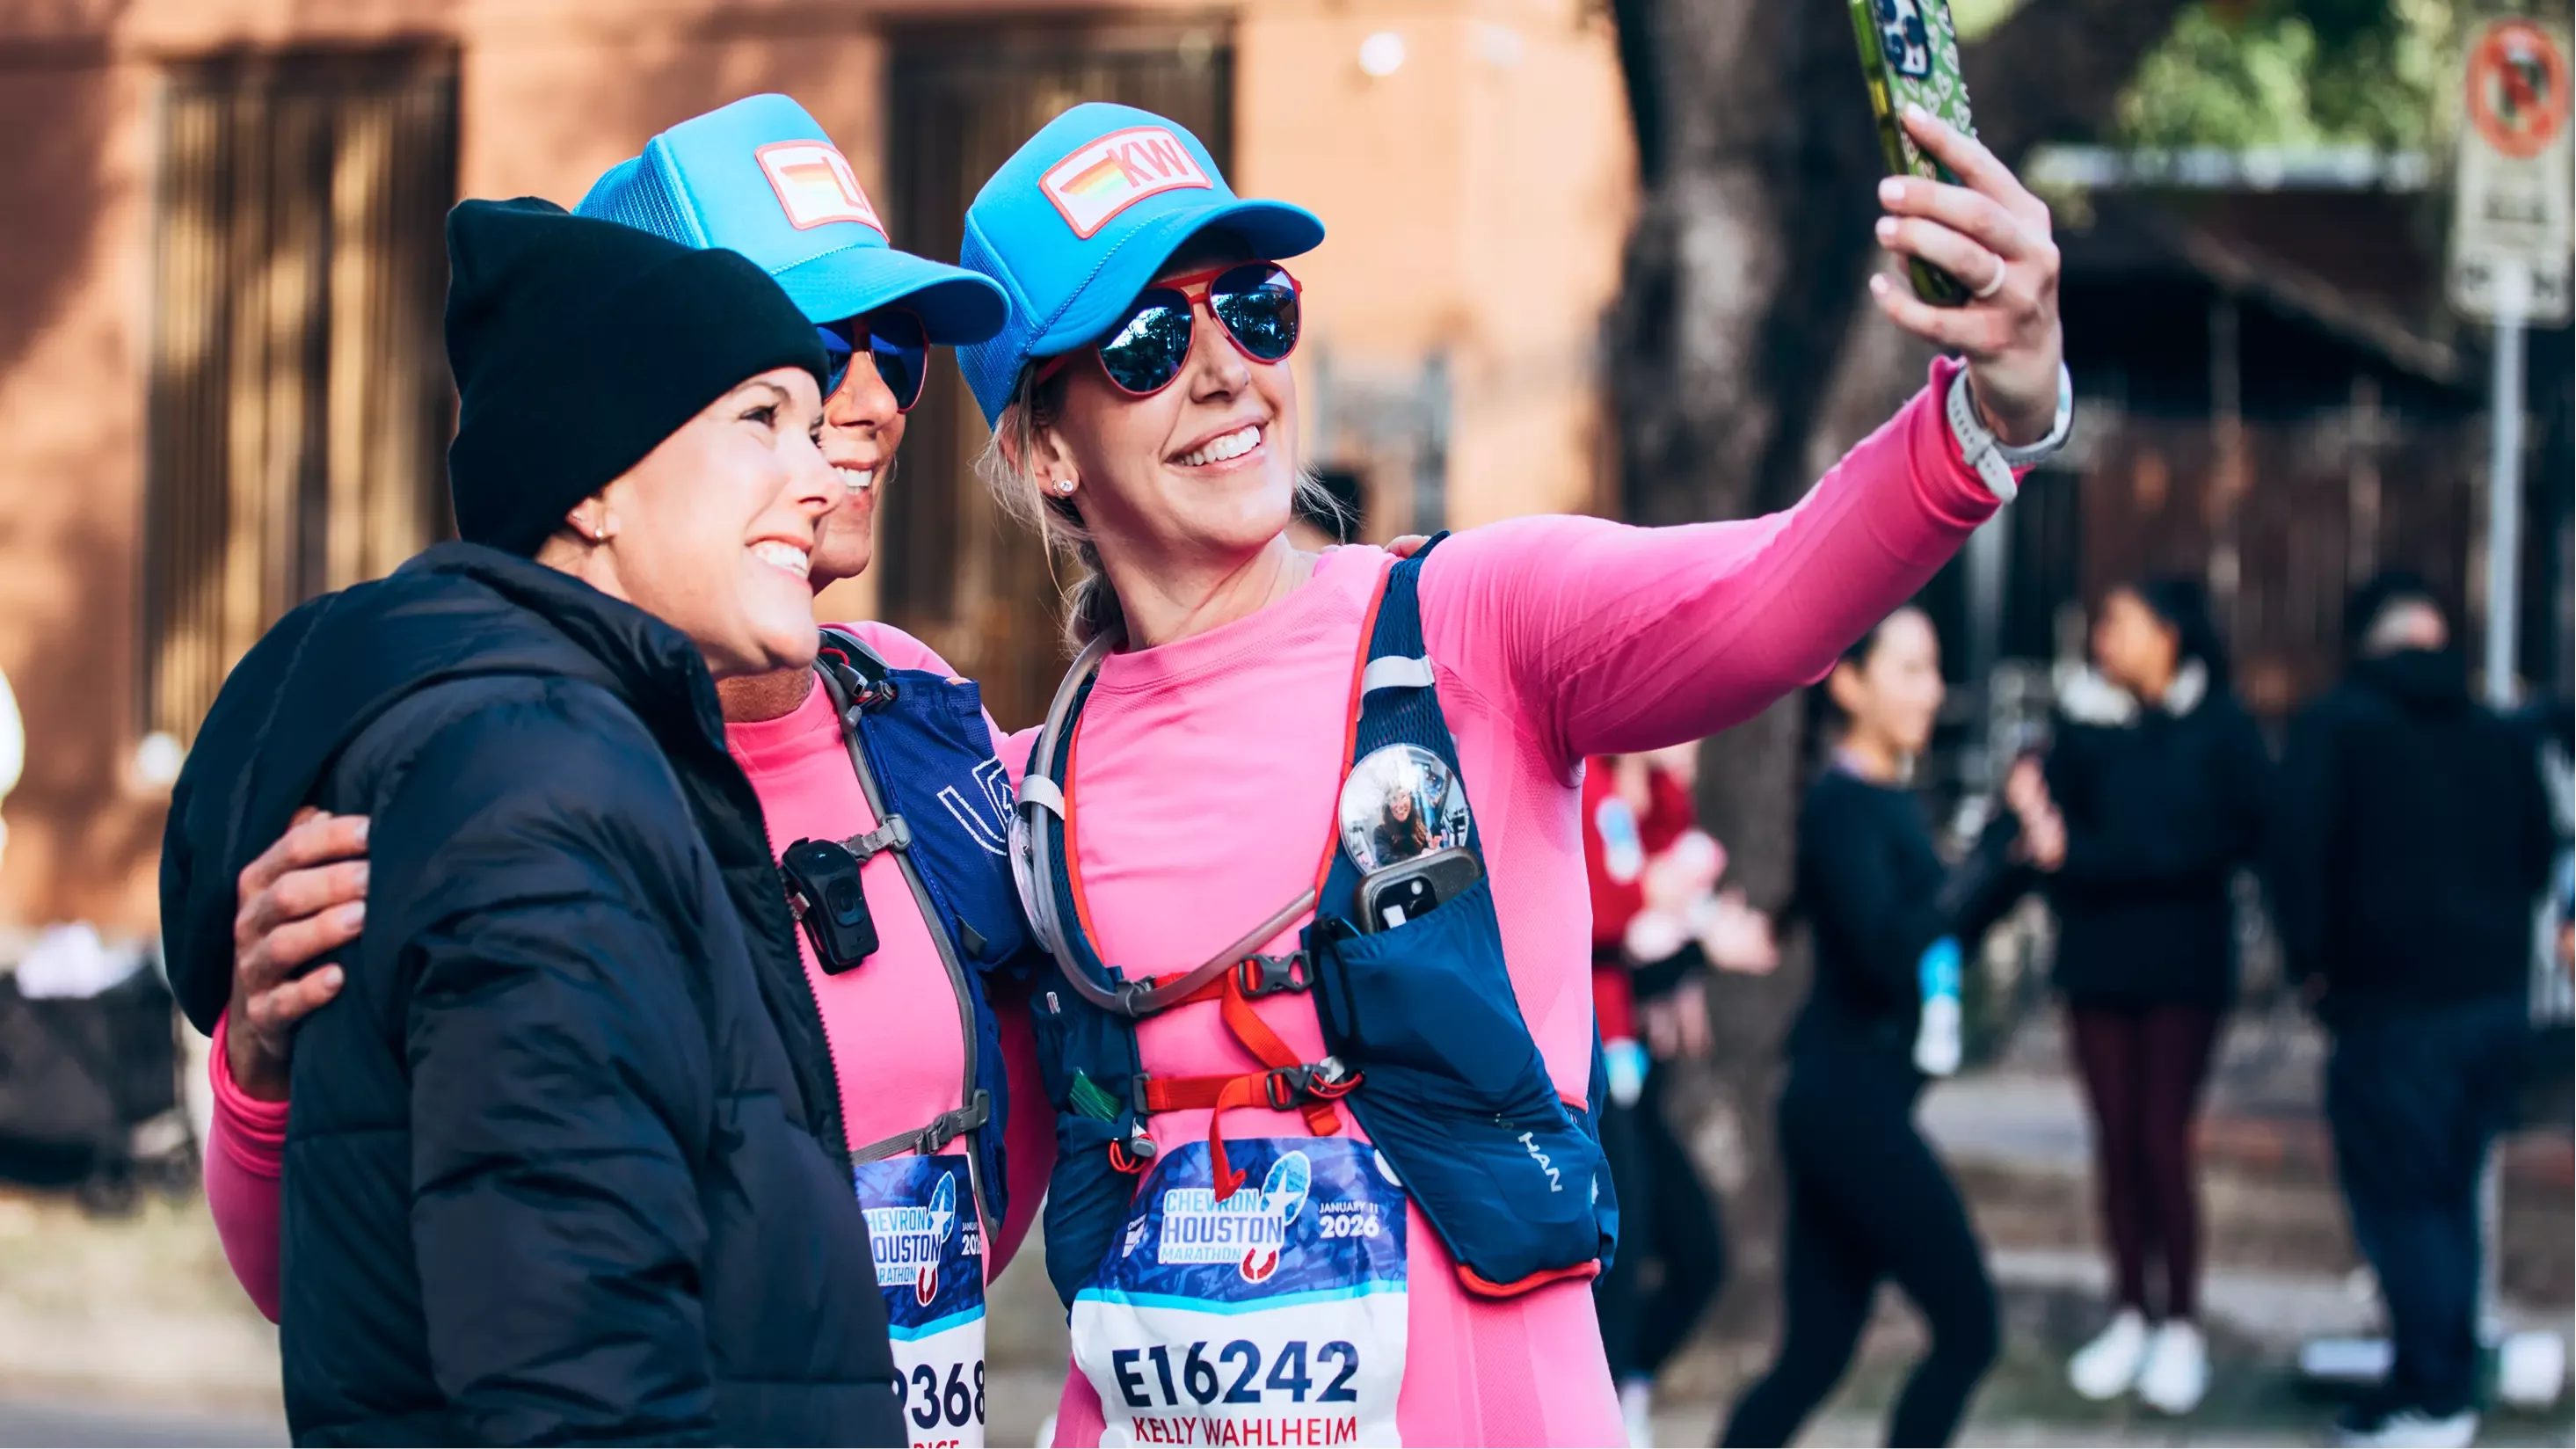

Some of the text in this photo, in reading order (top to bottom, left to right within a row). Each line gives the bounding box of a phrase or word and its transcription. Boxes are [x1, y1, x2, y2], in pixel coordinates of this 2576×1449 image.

[1106, 139, 1190, 188] KW
[1517, 1132, 1563, 1192] HAN
[862, 1209, 926, 1233] HEVRON
[1319, 1201, 1379, 1213] JANUARY 11
[1163, 1216, 1283, 1244] HOUSTON
[1319, 1214, 1380, 1239] 2026
[872, 1234, 942, 1263] OUSTON
[1161, 1247, 1242, 1261] MARATHON
[879, 1266, 916, 1283] RATHON
[1112, 1339, 1359, 1408] E16242
[1132, 1416, 1357, 1446] KELLY WAHLHEIM
